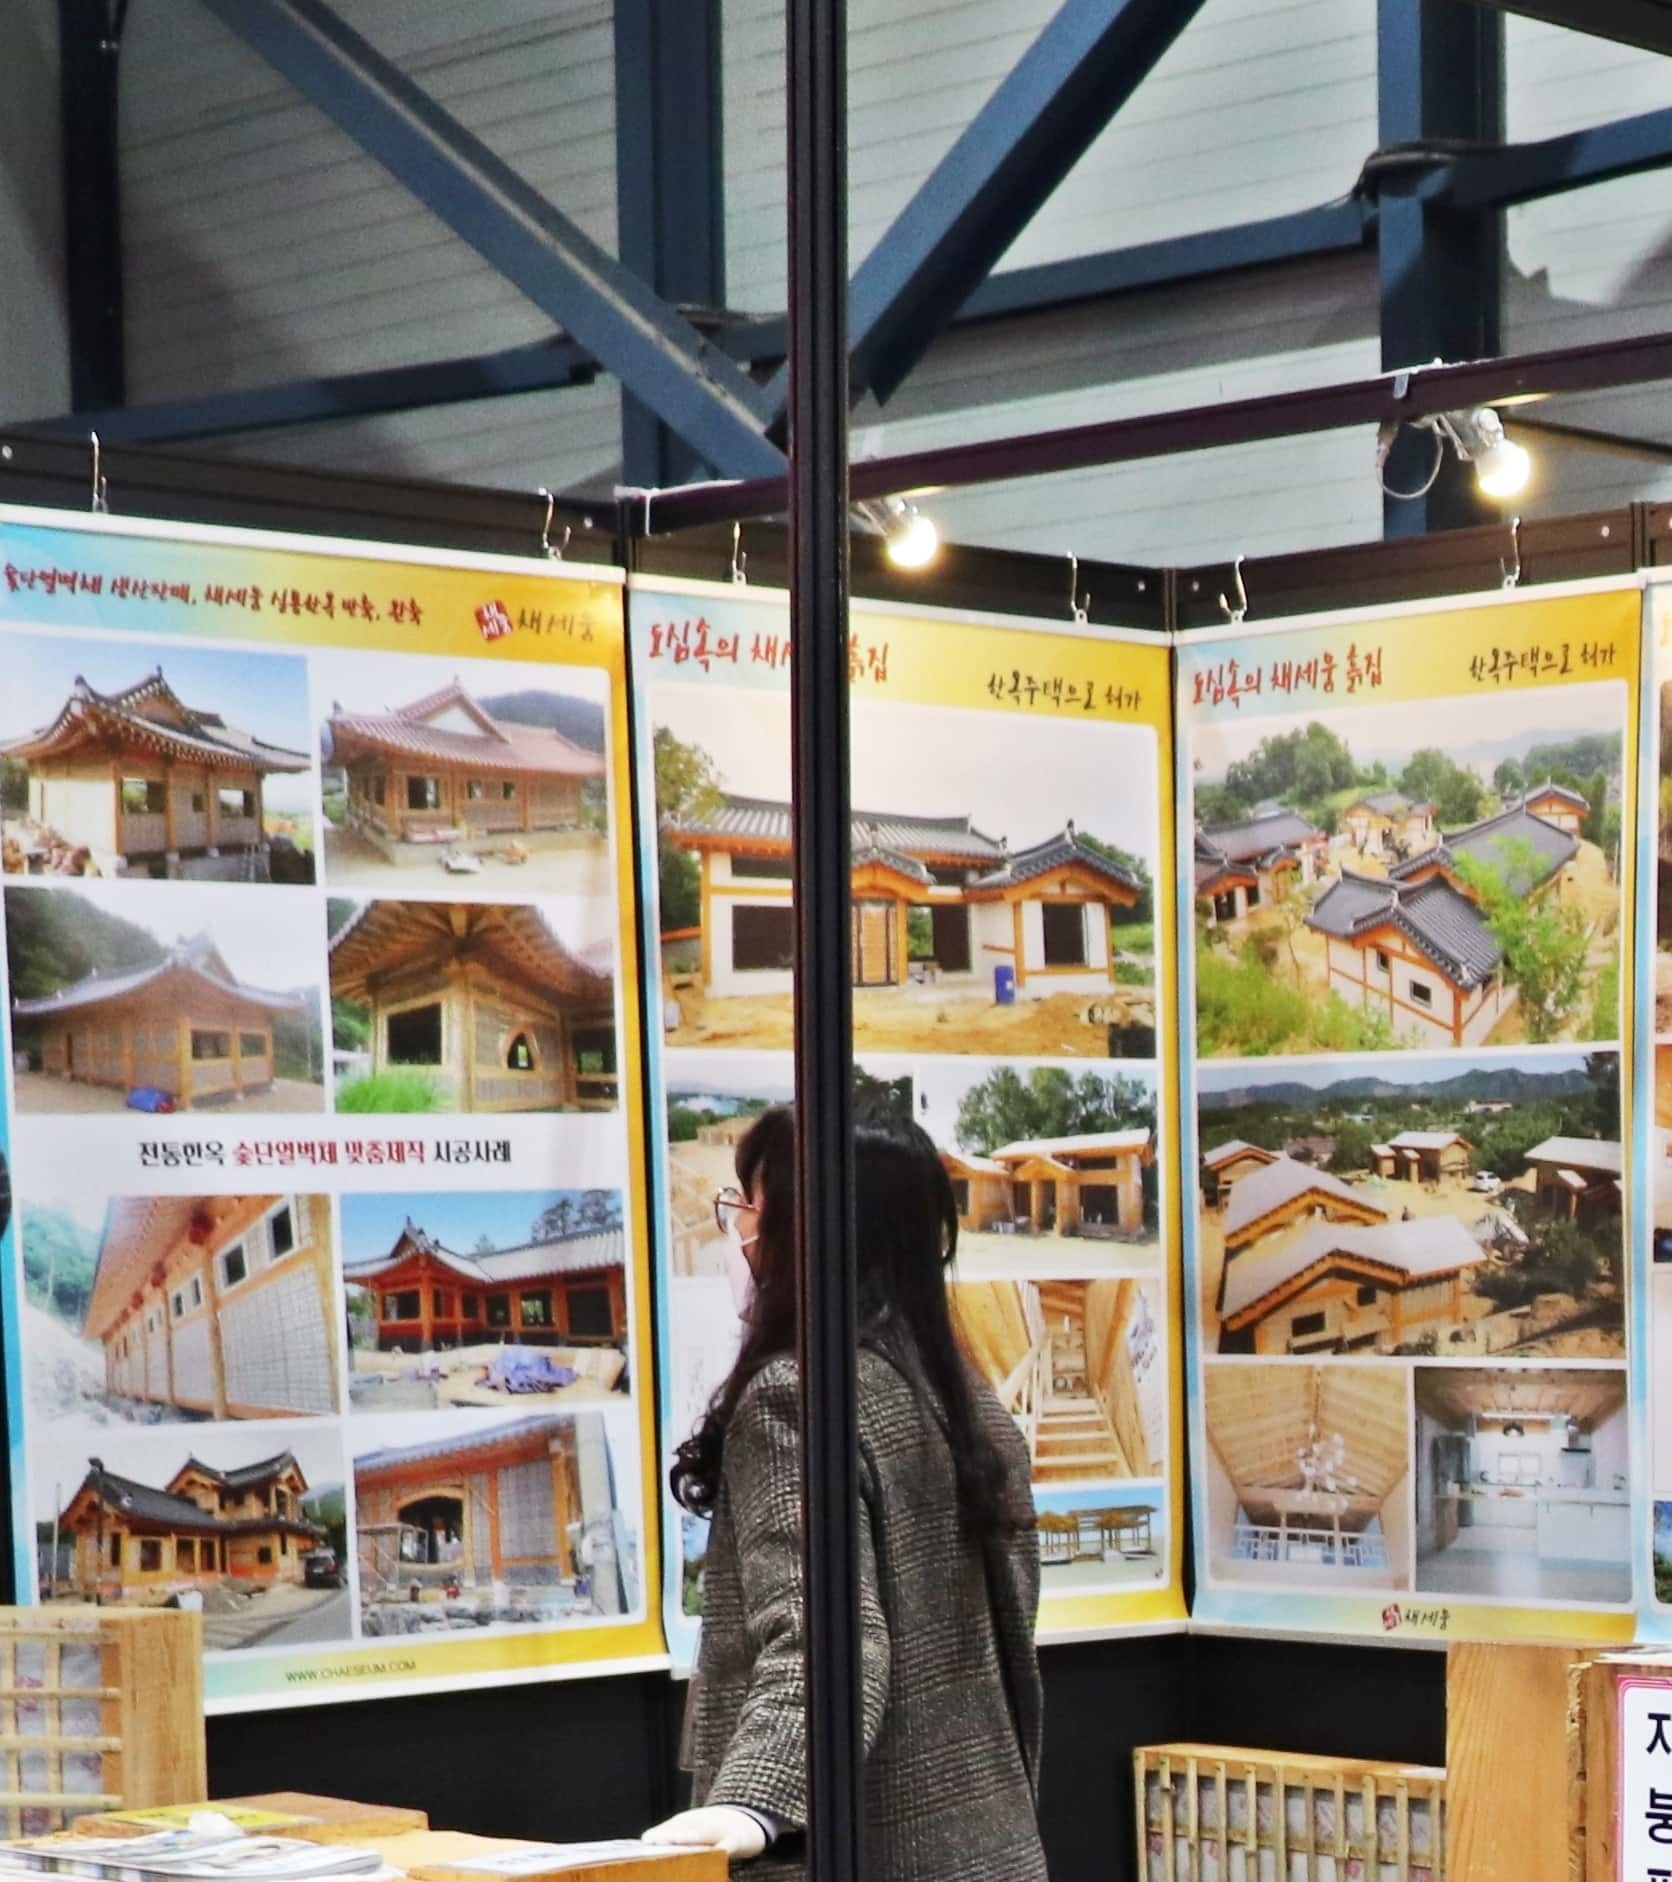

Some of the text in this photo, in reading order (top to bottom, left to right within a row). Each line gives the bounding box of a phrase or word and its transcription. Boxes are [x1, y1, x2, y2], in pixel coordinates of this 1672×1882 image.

[649, 616, 739, 673] 도심속의
[1470, 641, 1617, 685] 한옥주택으로 허가
[988, 669, 1143, 711] 한옥주택으로 허가
[1193, 642, 1383, 709] 도심속의 채세움 흙집
[140, 1139, 512, 1167] 전통한옥 숯단열벽체 맞춤제작 시공사례
